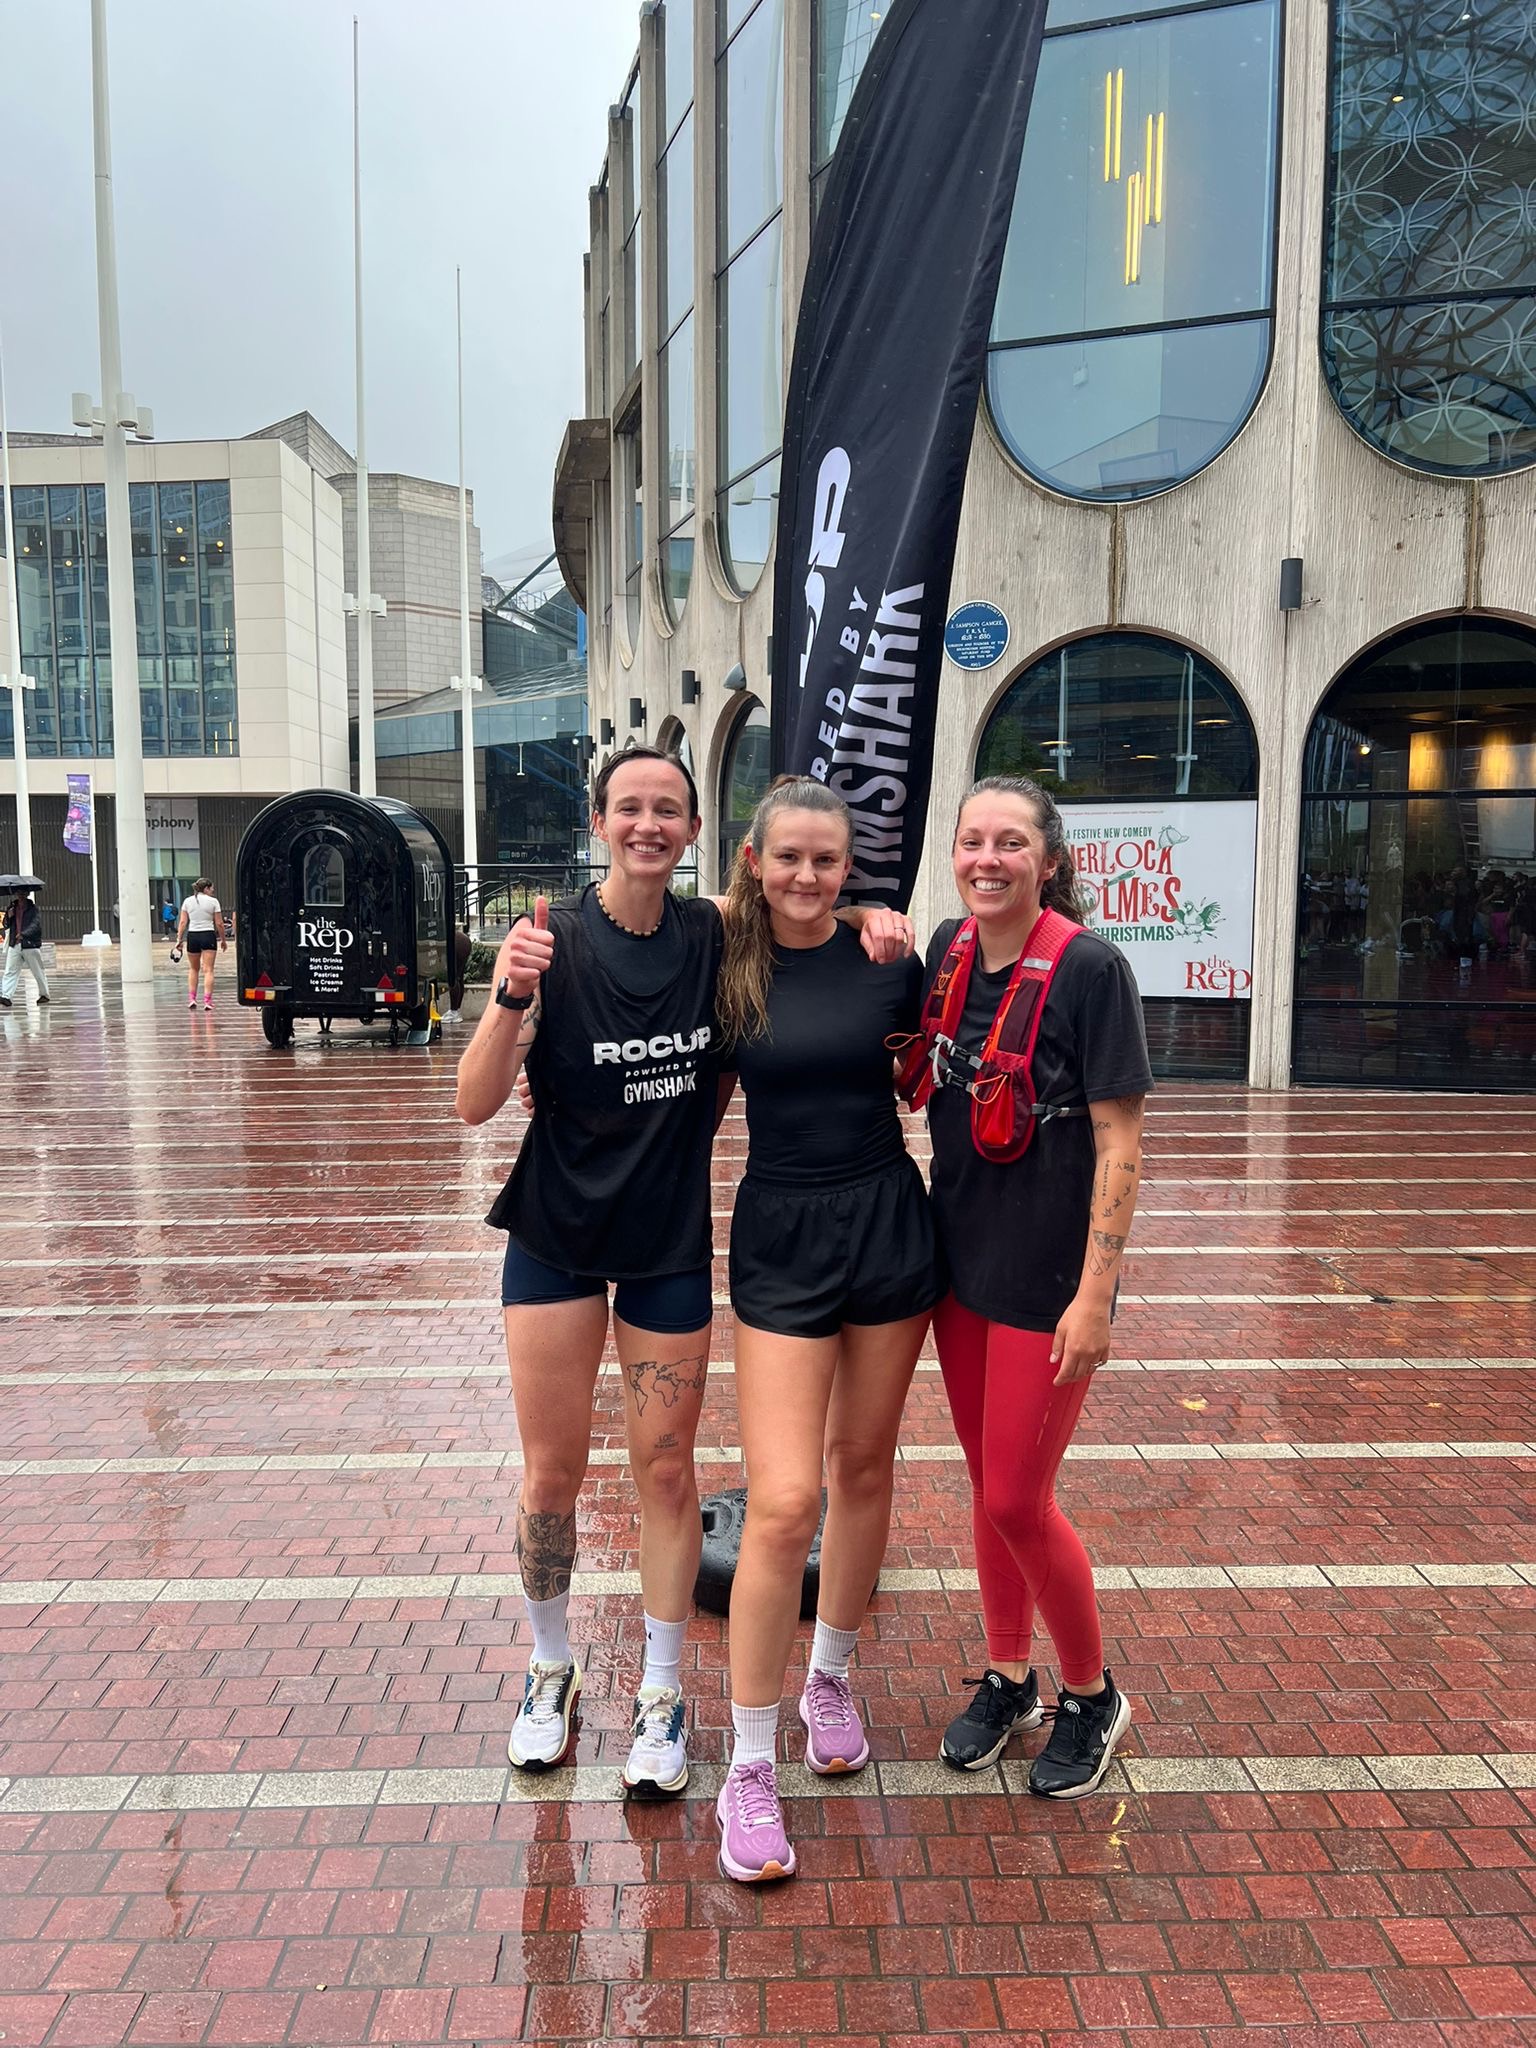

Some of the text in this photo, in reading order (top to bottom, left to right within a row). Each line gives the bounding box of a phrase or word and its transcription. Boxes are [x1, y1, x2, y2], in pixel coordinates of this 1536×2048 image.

[839, 586, 868, 655] BY
[1065, 826, 1153, 840] A FESTIVE NEW COMEDY
[316, 916, 336, 929] the
[297, 922, 354, 956] Rep
[1207, 954, 1232, 969] the
[1184, 960, 1251, 999] Rep
[593, 1026, 711, 1065] ROCUP
[625, 1063, 680, 1078] POWERED
